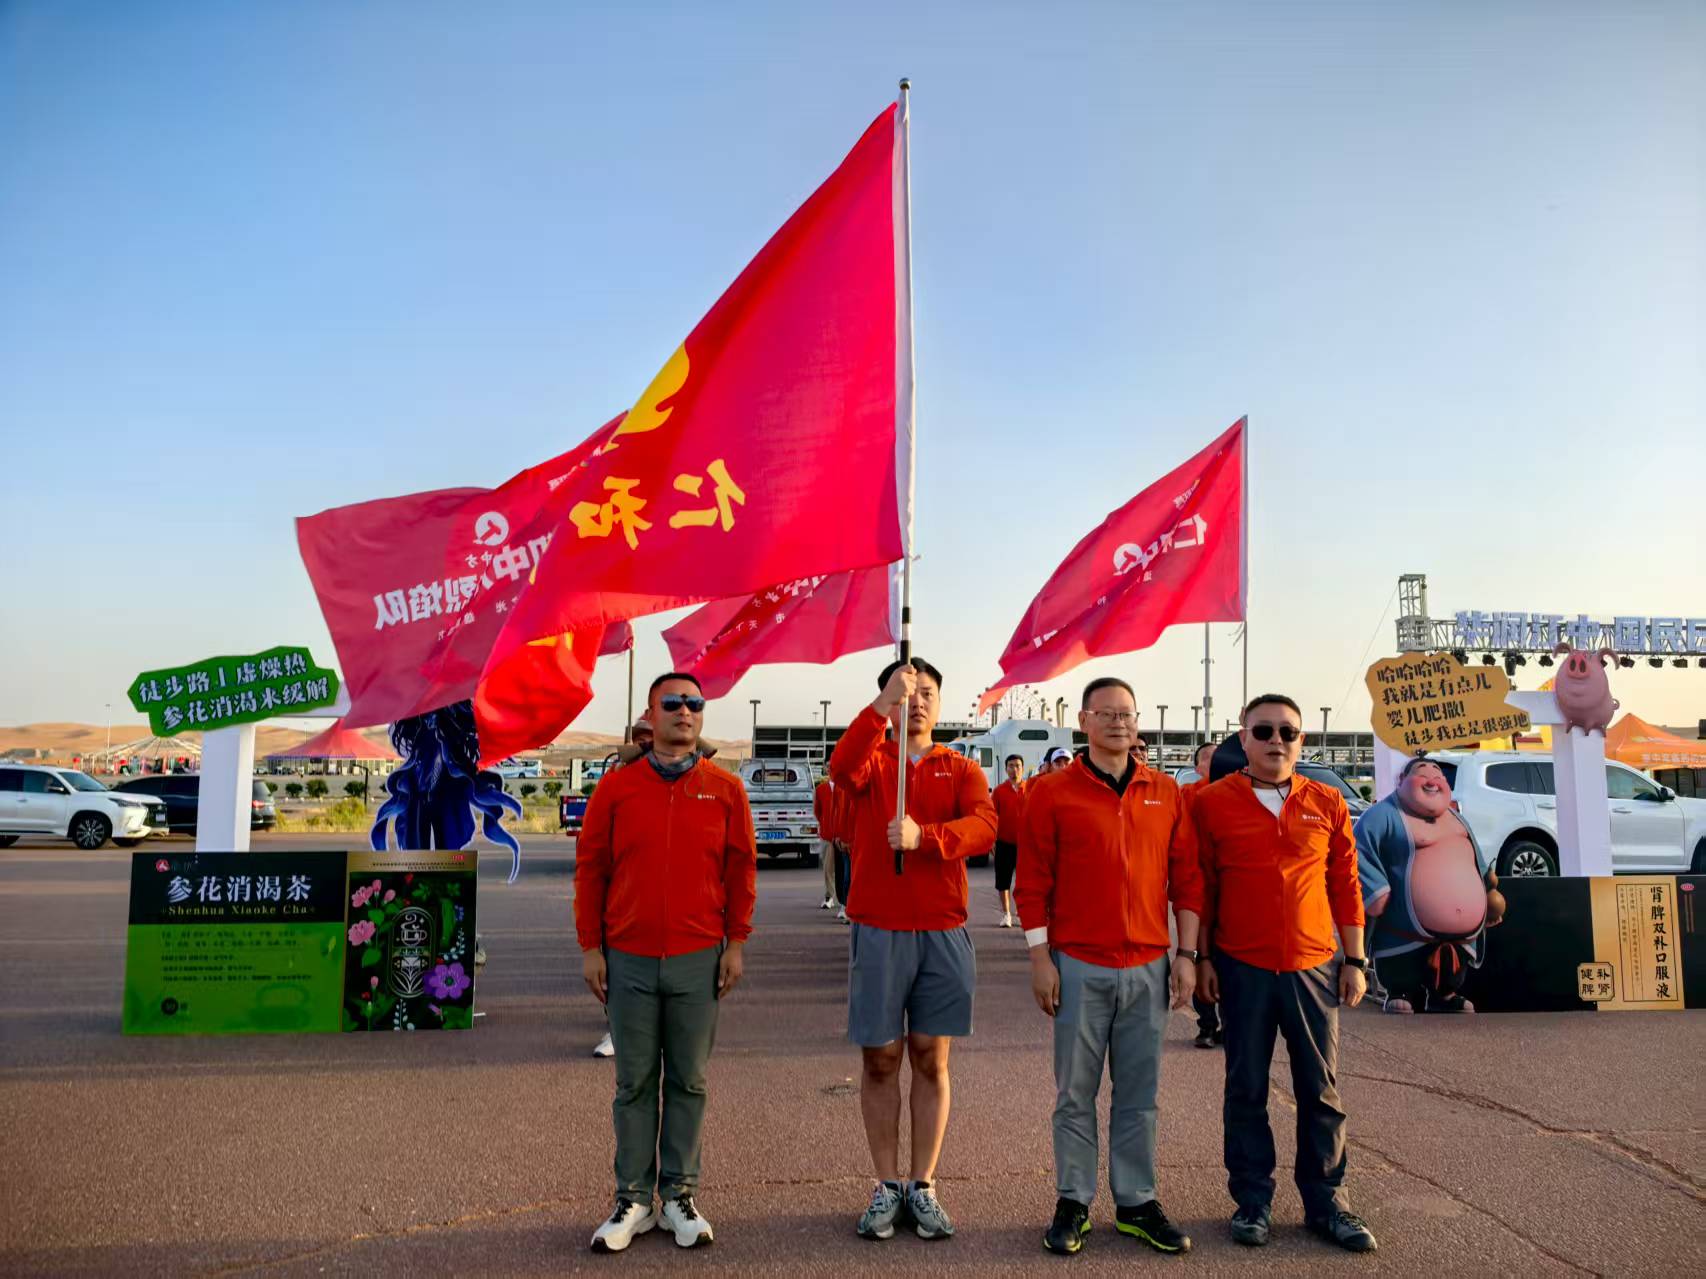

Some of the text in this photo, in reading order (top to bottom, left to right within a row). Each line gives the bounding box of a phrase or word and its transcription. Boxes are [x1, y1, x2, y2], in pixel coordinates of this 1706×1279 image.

[1377, 657, 1451, 684] 哈哈哈哈
[1382, 672, 1492, 706] 我就是有点儿
[1404, 712, 1529, 746] 徒步我还是很强地
[167, 875, 312, 903] 参花消渴茶
[168, 904, 307, 915] Shenhua Xiaoke Cha
[1650, 886, 1671, 999] 肾脾双补口服液
